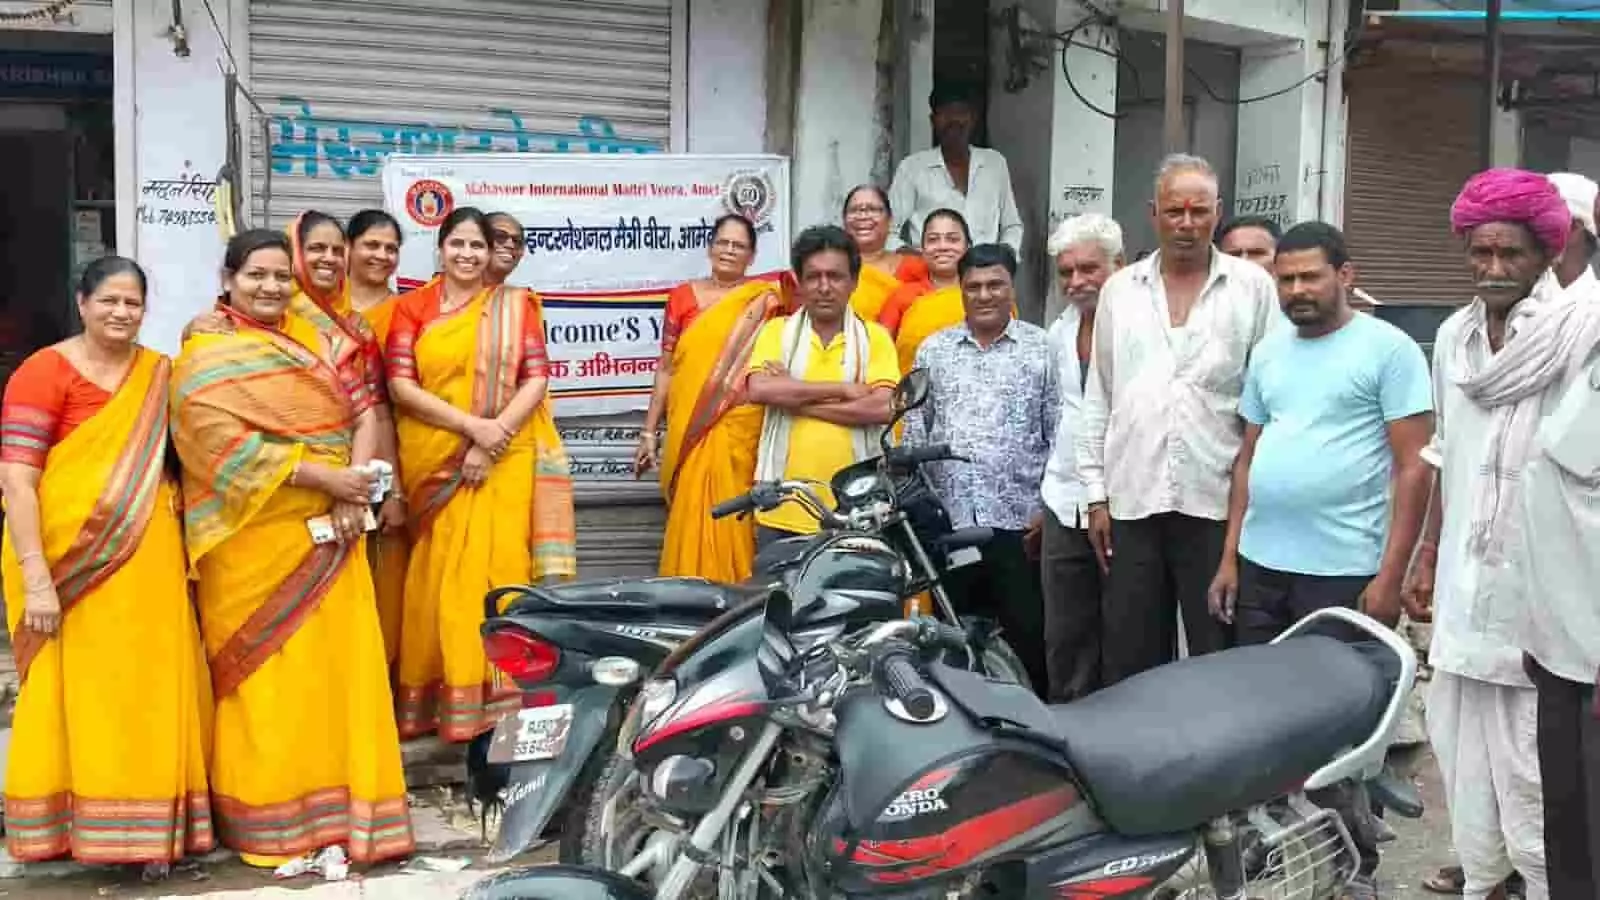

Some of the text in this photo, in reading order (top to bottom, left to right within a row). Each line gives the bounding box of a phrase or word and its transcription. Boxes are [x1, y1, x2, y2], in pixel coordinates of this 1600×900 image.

[529, 183, 609, 197] International
[543, 315, 641, 345] lcome'S
[884, 799, 949, 816] ONDA
